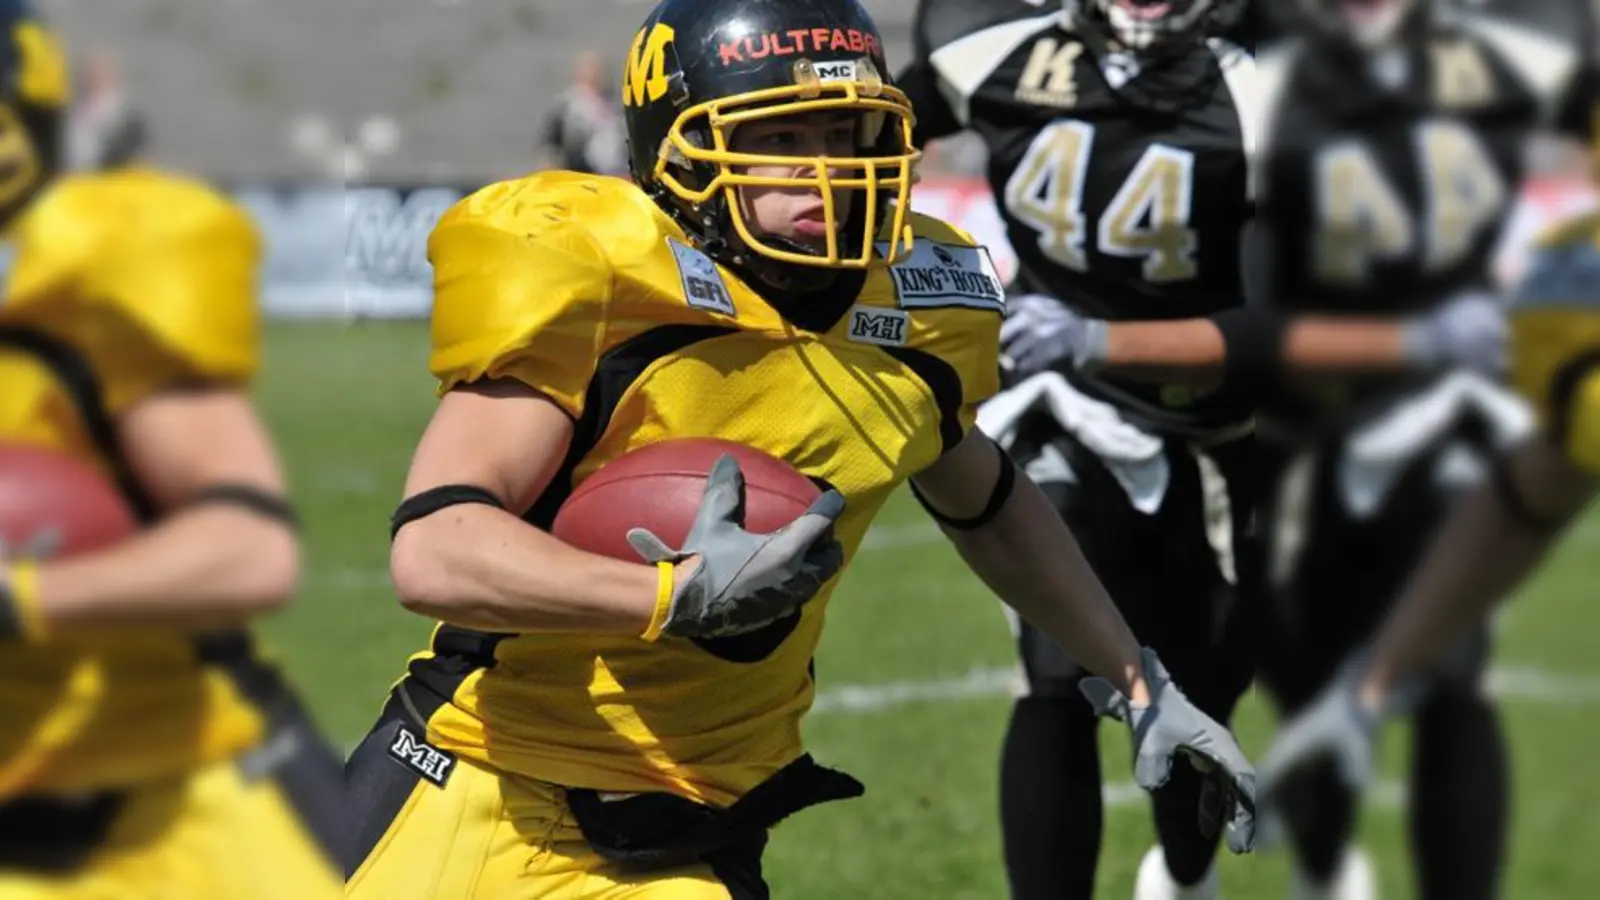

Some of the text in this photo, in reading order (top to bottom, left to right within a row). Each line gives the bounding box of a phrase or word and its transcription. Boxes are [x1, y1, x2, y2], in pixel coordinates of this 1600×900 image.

[817, 66, 851, 78] MC
[1004, 119, 1197, 283] 44
[851, 311, 905, 341] MH
[391, 728, 451, 781] MH
